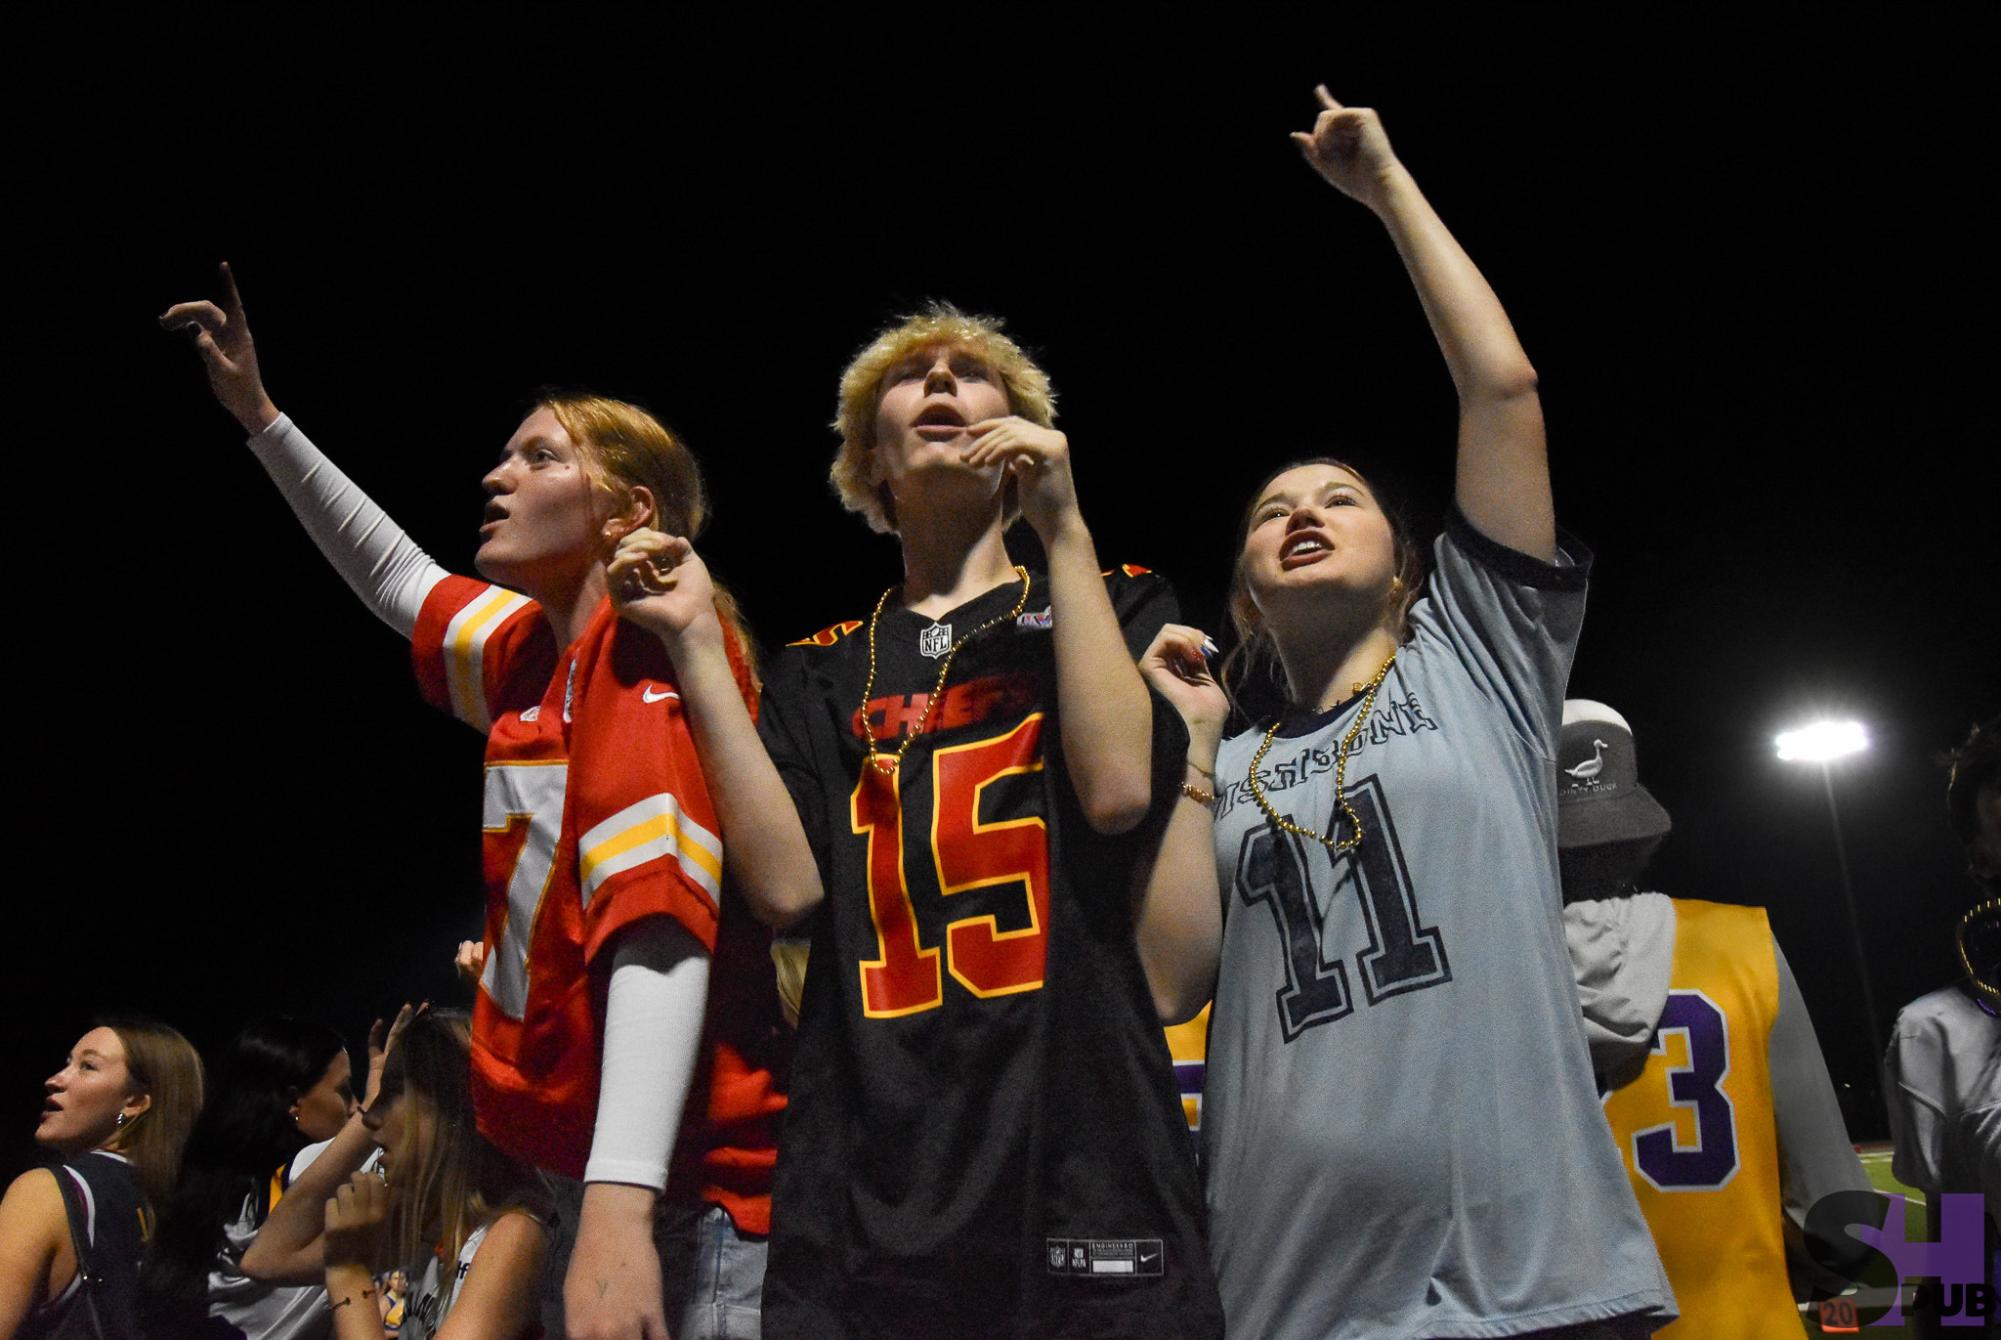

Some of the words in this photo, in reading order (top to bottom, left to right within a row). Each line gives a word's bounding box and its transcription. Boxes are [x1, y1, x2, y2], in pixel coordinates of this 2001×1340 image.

[924, 635, 948, 652] NFL
[1212, 691, 1438, 821] ISHBONE
[850, 711, 1051, 1019] 15
[1235, 773, 1452, 1044] 11
[1599, 988, 1742, 1194] 3
[1823, 1302, 1854, 1326] 20
